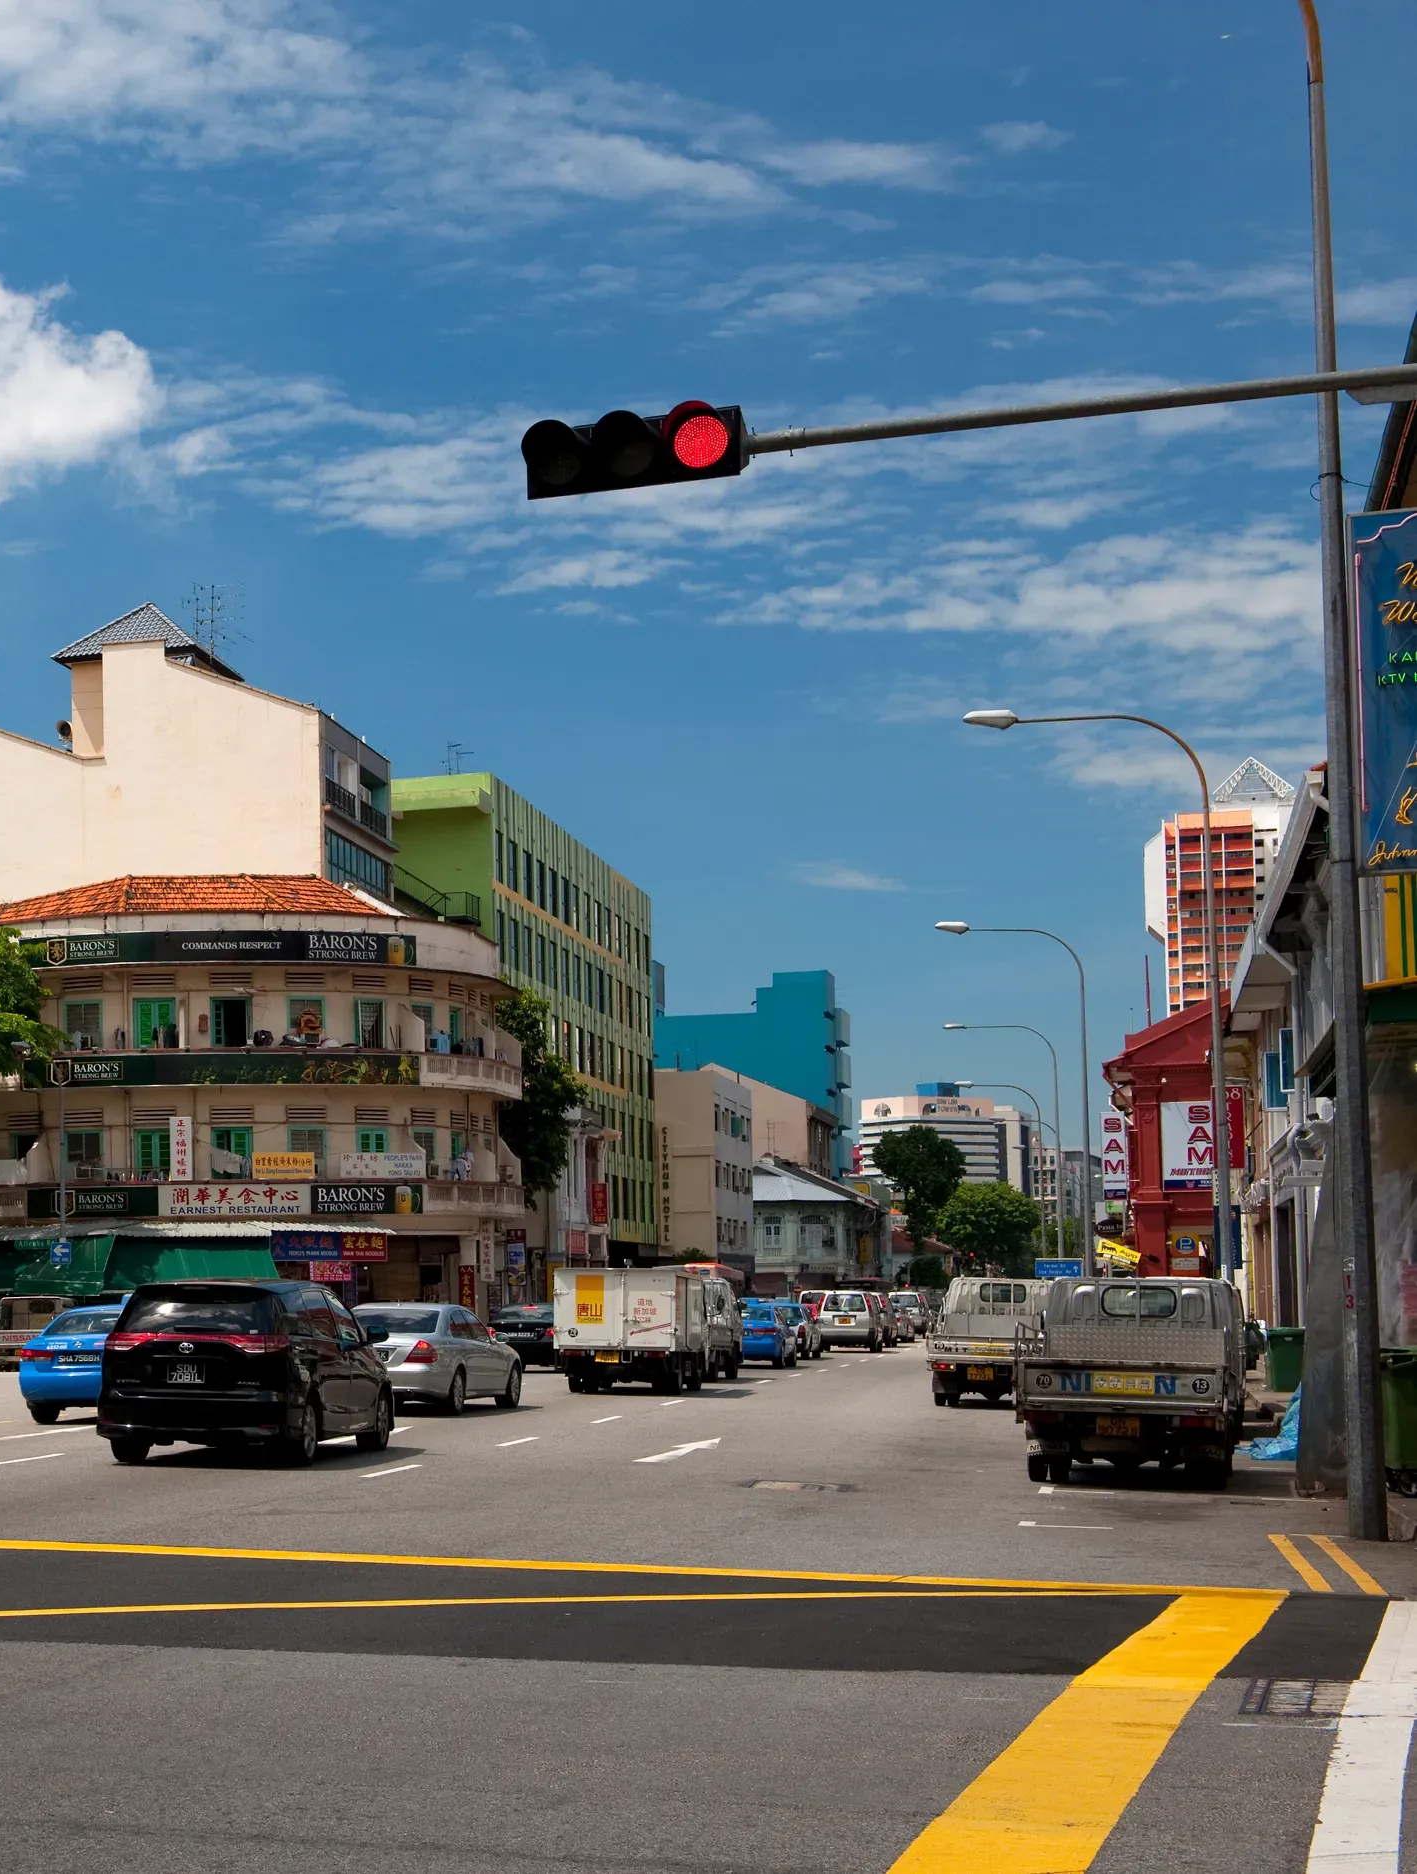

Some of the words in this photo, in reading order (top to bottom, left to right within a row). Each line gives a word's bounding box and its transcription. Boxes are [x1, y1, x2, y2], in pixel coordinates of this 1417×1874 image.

[1388, 653, 1417, 664] KA
[1378, 672, 1406, 686] KTV
[1368, 841, 1417, 867] Johnn
[69, 940, 115, 952] BARON'S
[181, 941, 237, 950] COMMANDS
[239, 941, 282, 950] RESPECT
[308, 934, 378, 950] BARON'S
[308, 950, 349, 959] STRONG
[351, 951, 377, 960] BREW
[73, 1062, 120, 1073] BARON'S
[936, 1098, 947, 1106] SIM
[1187, 1105, 1213, 1165] SAM
[1103, 1117, 1125, 1175] SAM
[78, 1193, 124, 1204] BARON'S
[317, 1187, 385, 1203] BARON'S
[170, 1206, 223, 1215] EARNEST
[228, 1205, 301, 1215] RESTAURANT
[317, 1202, 358, 1212] STRONG
[359, 1202, 385, 1212] BREW
[662, 1196, 670, 1243] HOTEL
[1097, 1223, 1114, 1231] Pasta
[17, 1240, 44, 1249] Allenby
[577, 1303, 603, 1318] 唐山
[633, 1307, 658, 1316] 新加坡
[58, 1354, 100, 1363] SHA7568H
[176, 1363, 197, 1373] SDU
[170, 1372, 202, 1382] 7081L
[1038, 1374, 1050, 1384] 70
[1195, 1379, 1208, 1389] 13
